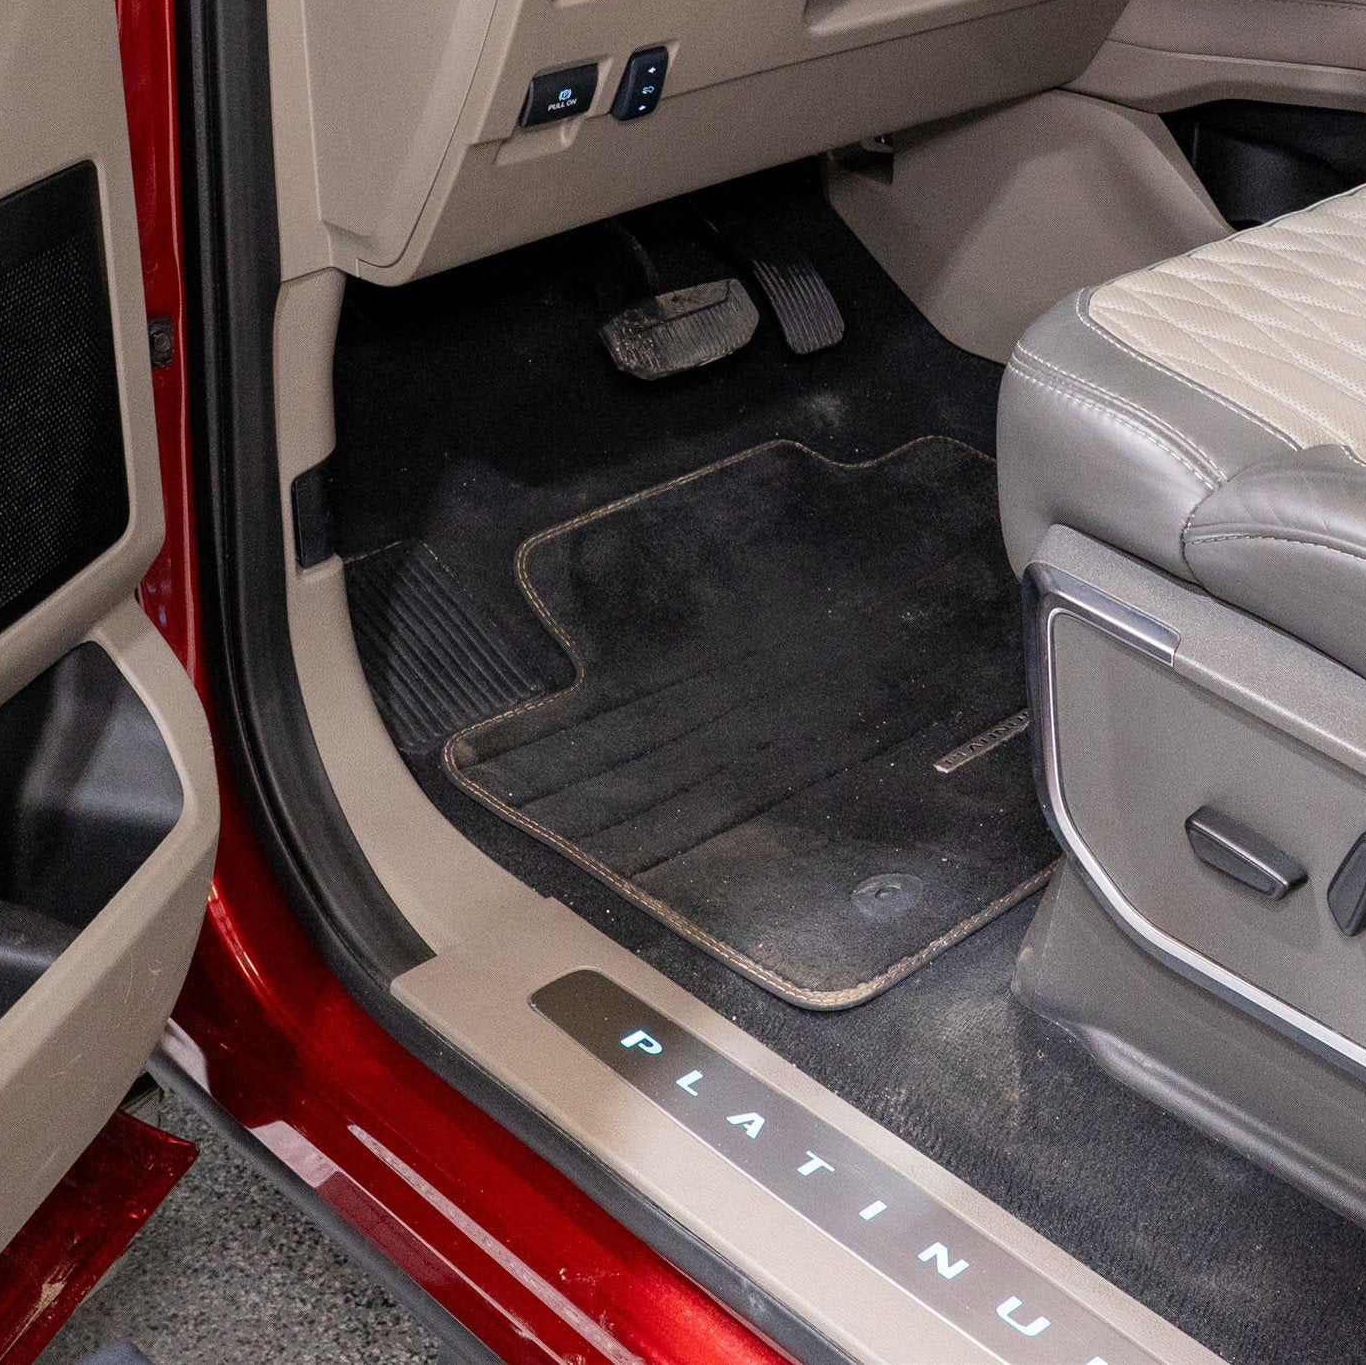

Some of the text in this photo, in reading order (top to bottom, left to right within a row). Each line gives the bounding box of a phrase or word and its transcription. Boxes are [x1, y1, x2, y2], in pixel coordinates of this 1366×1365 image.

[548, 99, 578, 111] PULL ON
[620, 1029, 1109, 1365] PLATINU
